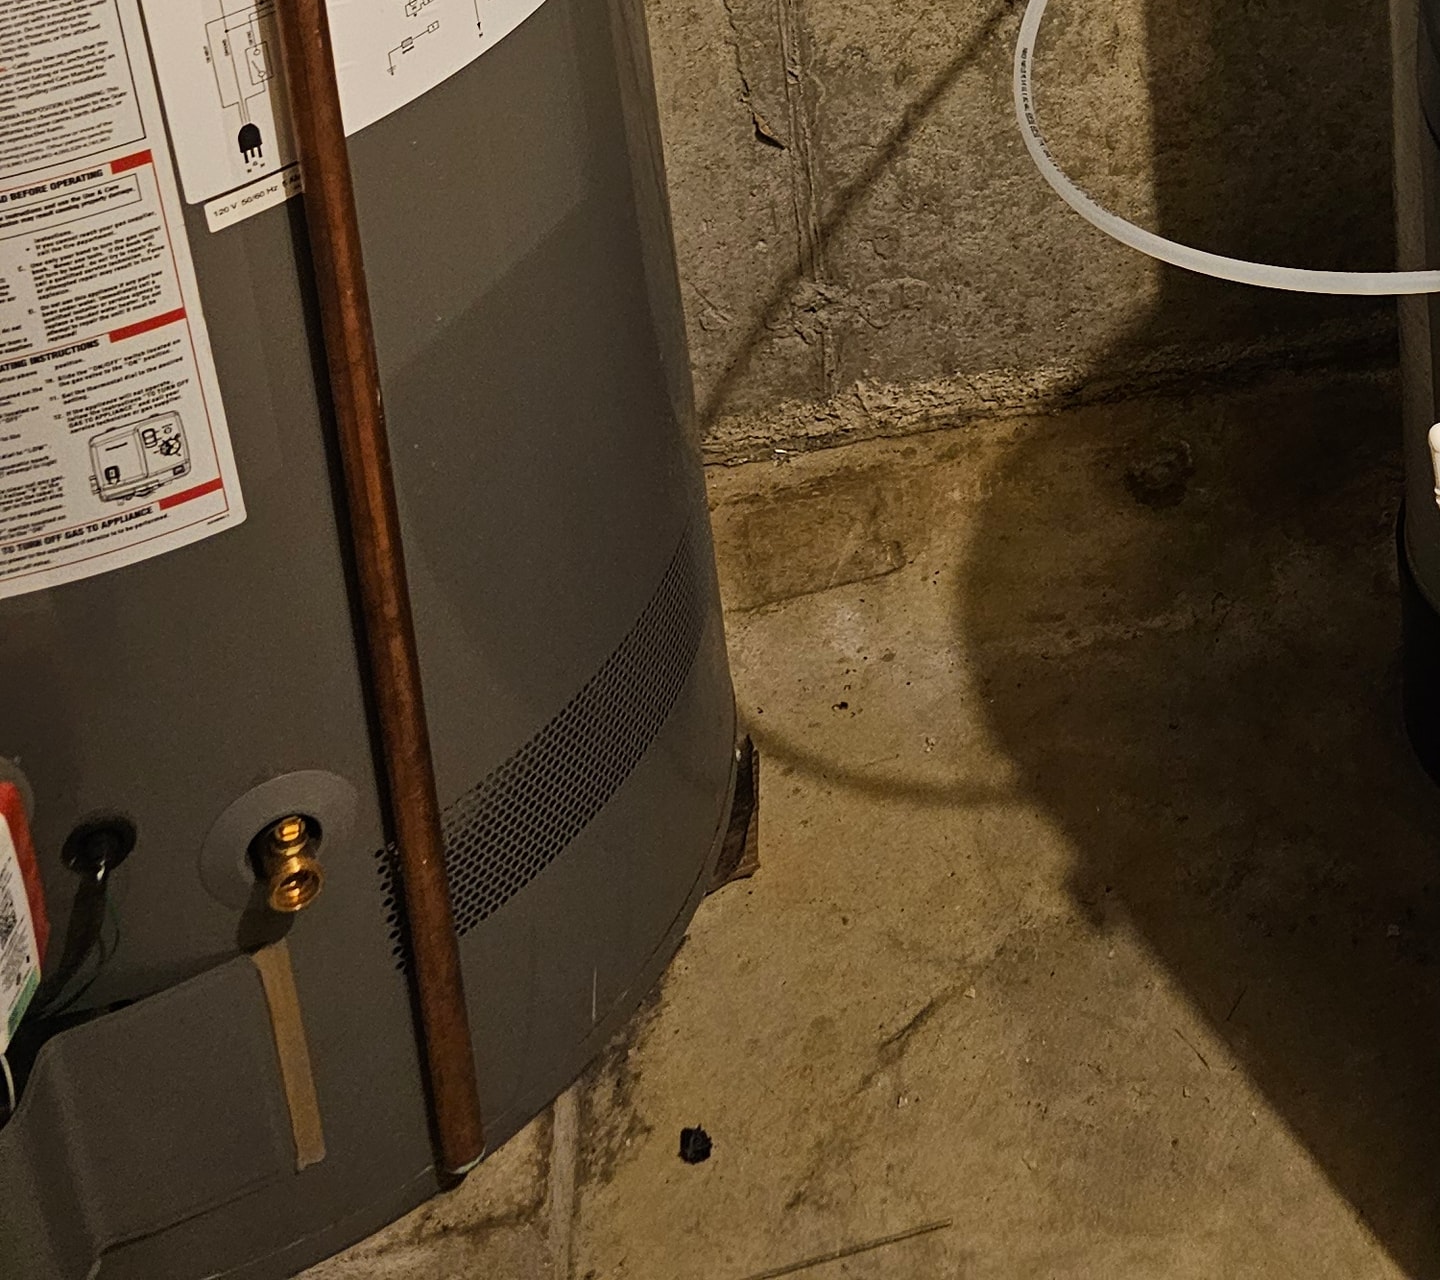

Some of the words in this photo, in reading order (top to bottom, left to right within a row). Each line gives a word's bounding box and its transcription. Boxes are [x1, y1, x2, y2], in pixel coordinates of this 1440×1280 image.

[10, 184, 47, 200] BEFORE
[50, 169, 102, 189] OPERATING
[214, 206, 229, 217] 120
[241, 191, 265, 206] 50/60
[30, 339, 99, 364] INSTRUCTIONS
[44, 533, 61, 544] OFF
[64, 527, 84, 539] GAS
[86, 523, 98, 532] TO
[101, 506, 152, 528] APPLIANCE
